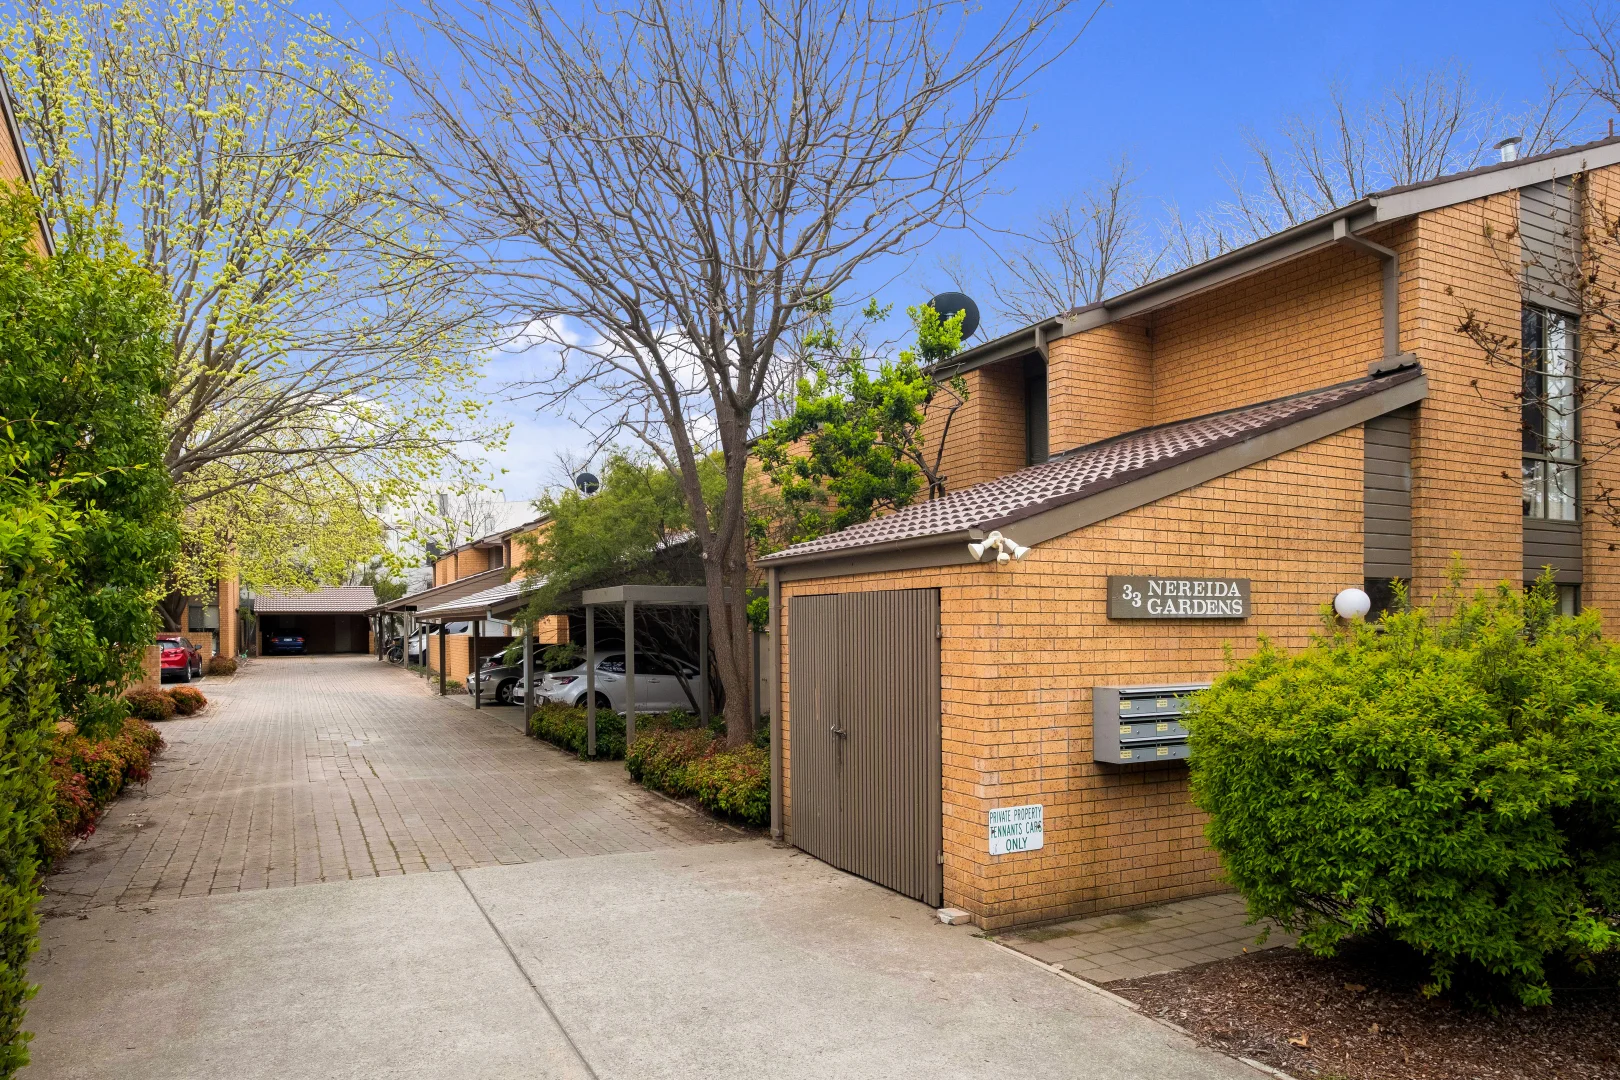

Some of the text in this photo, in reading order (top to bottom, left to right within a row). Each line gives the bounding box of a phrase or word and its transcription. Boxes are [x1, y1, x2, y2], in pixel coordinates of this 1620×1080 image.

[1122, 584, 1142, 607] 33
[1148, 580, 1241, 597] NEREIDA
[1147, 598, 1243, 615] GARDENS
[990, 807, 1042, 824] PRIVATE PROPERTY
[990, 820, 1042, 838] TENNANTS CARS
[1006, 837, 1028, 851] ONLY
